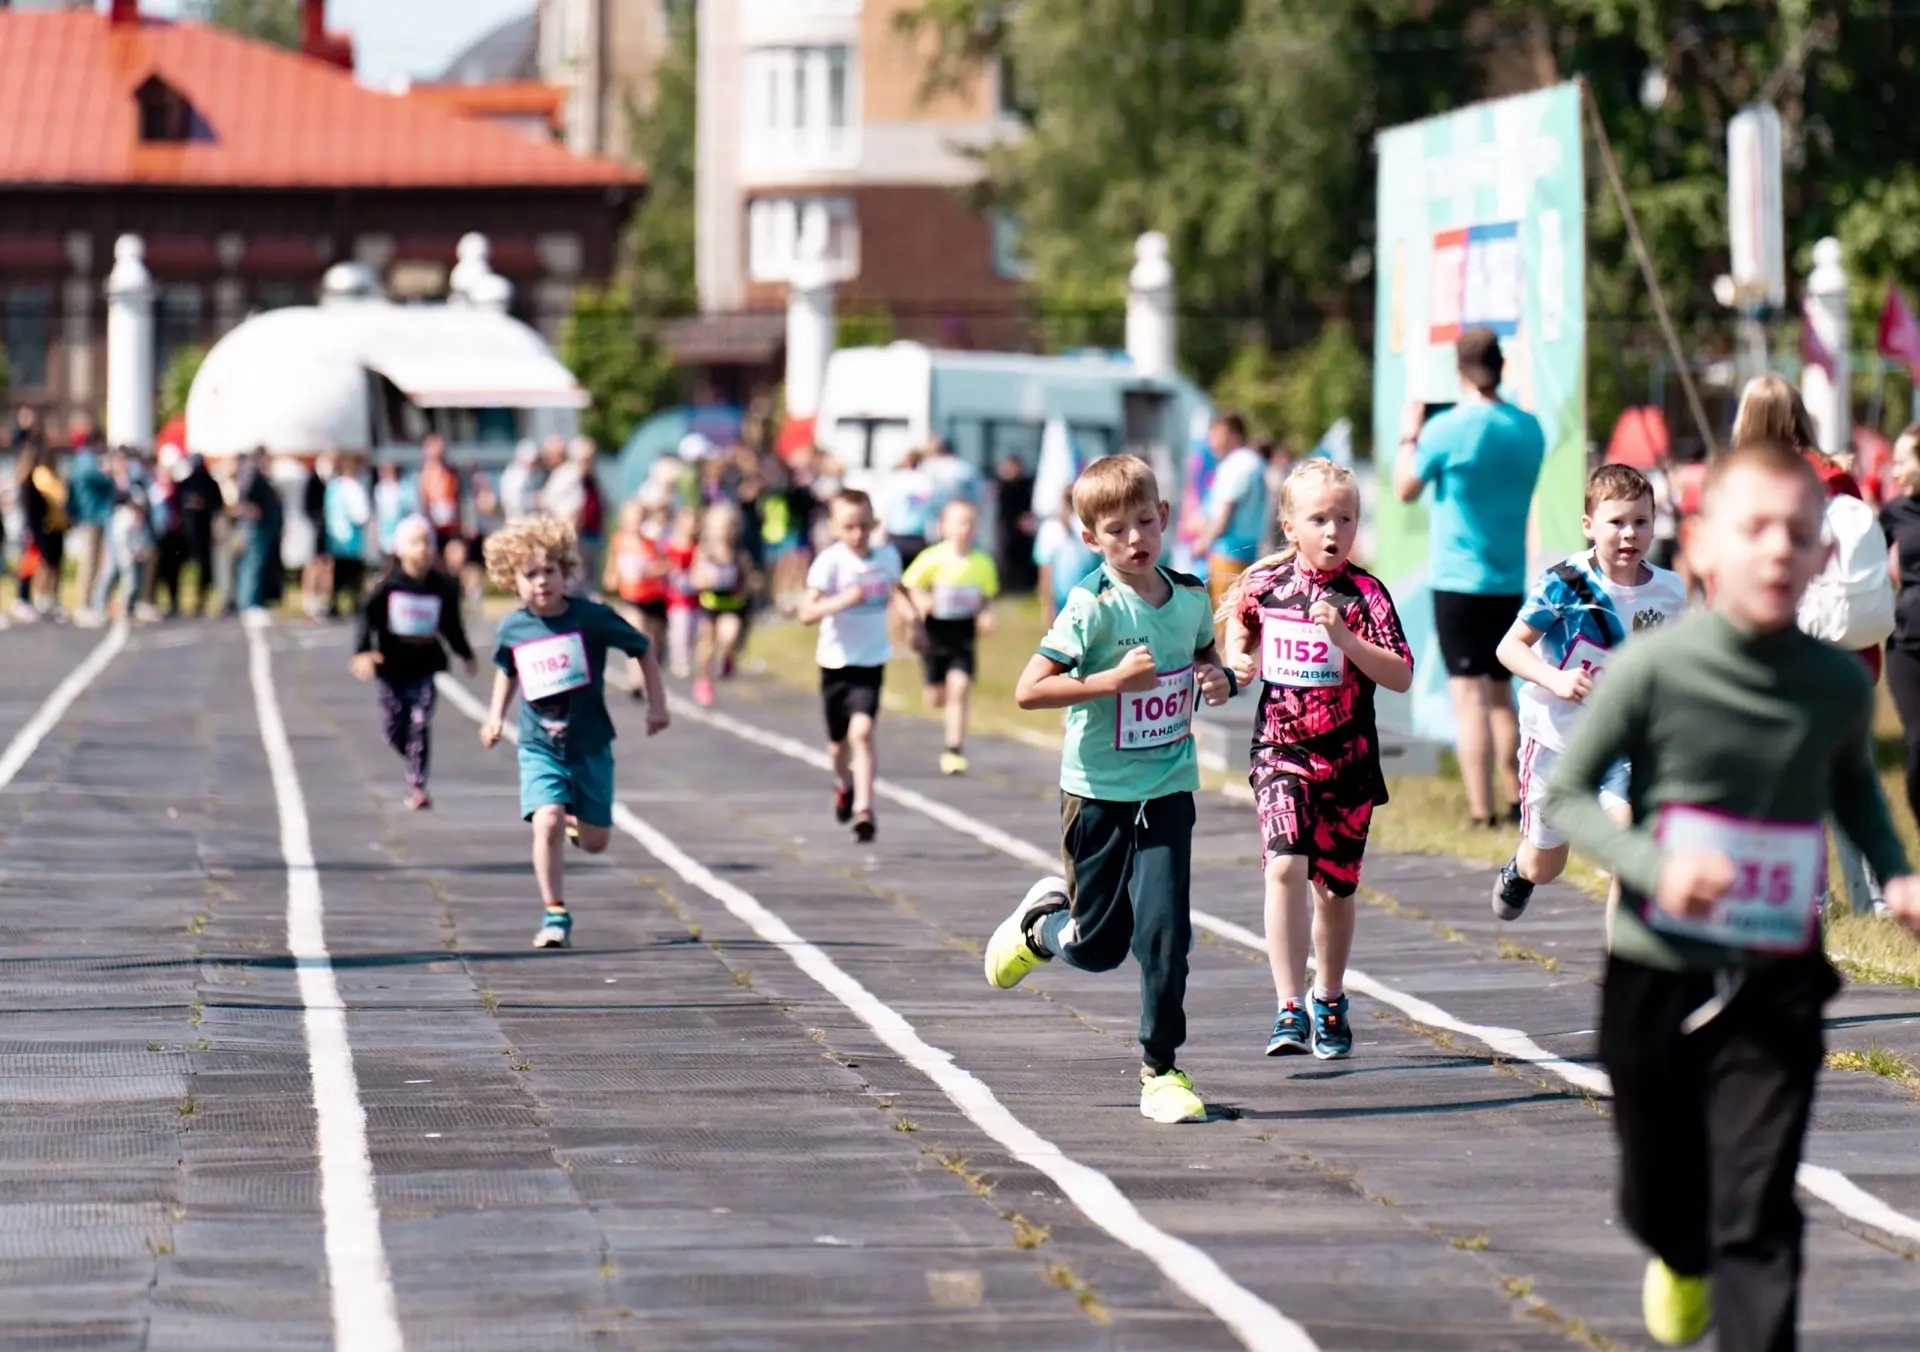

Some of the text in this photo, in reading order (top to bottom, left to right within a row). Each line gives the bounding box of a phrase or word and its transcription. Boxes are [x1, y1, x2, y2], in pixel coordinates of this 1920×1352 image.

[1118, 636, 1149, 646] KELME
[1274, 637, 1328, 663] 1152
[532, 653, 571, 675] 1182
[1277, 667, 1340, 679] ГАНДВИК
[1131, 688, 1188, 722] 1067
[1732, 860, 1793, 906] 35
